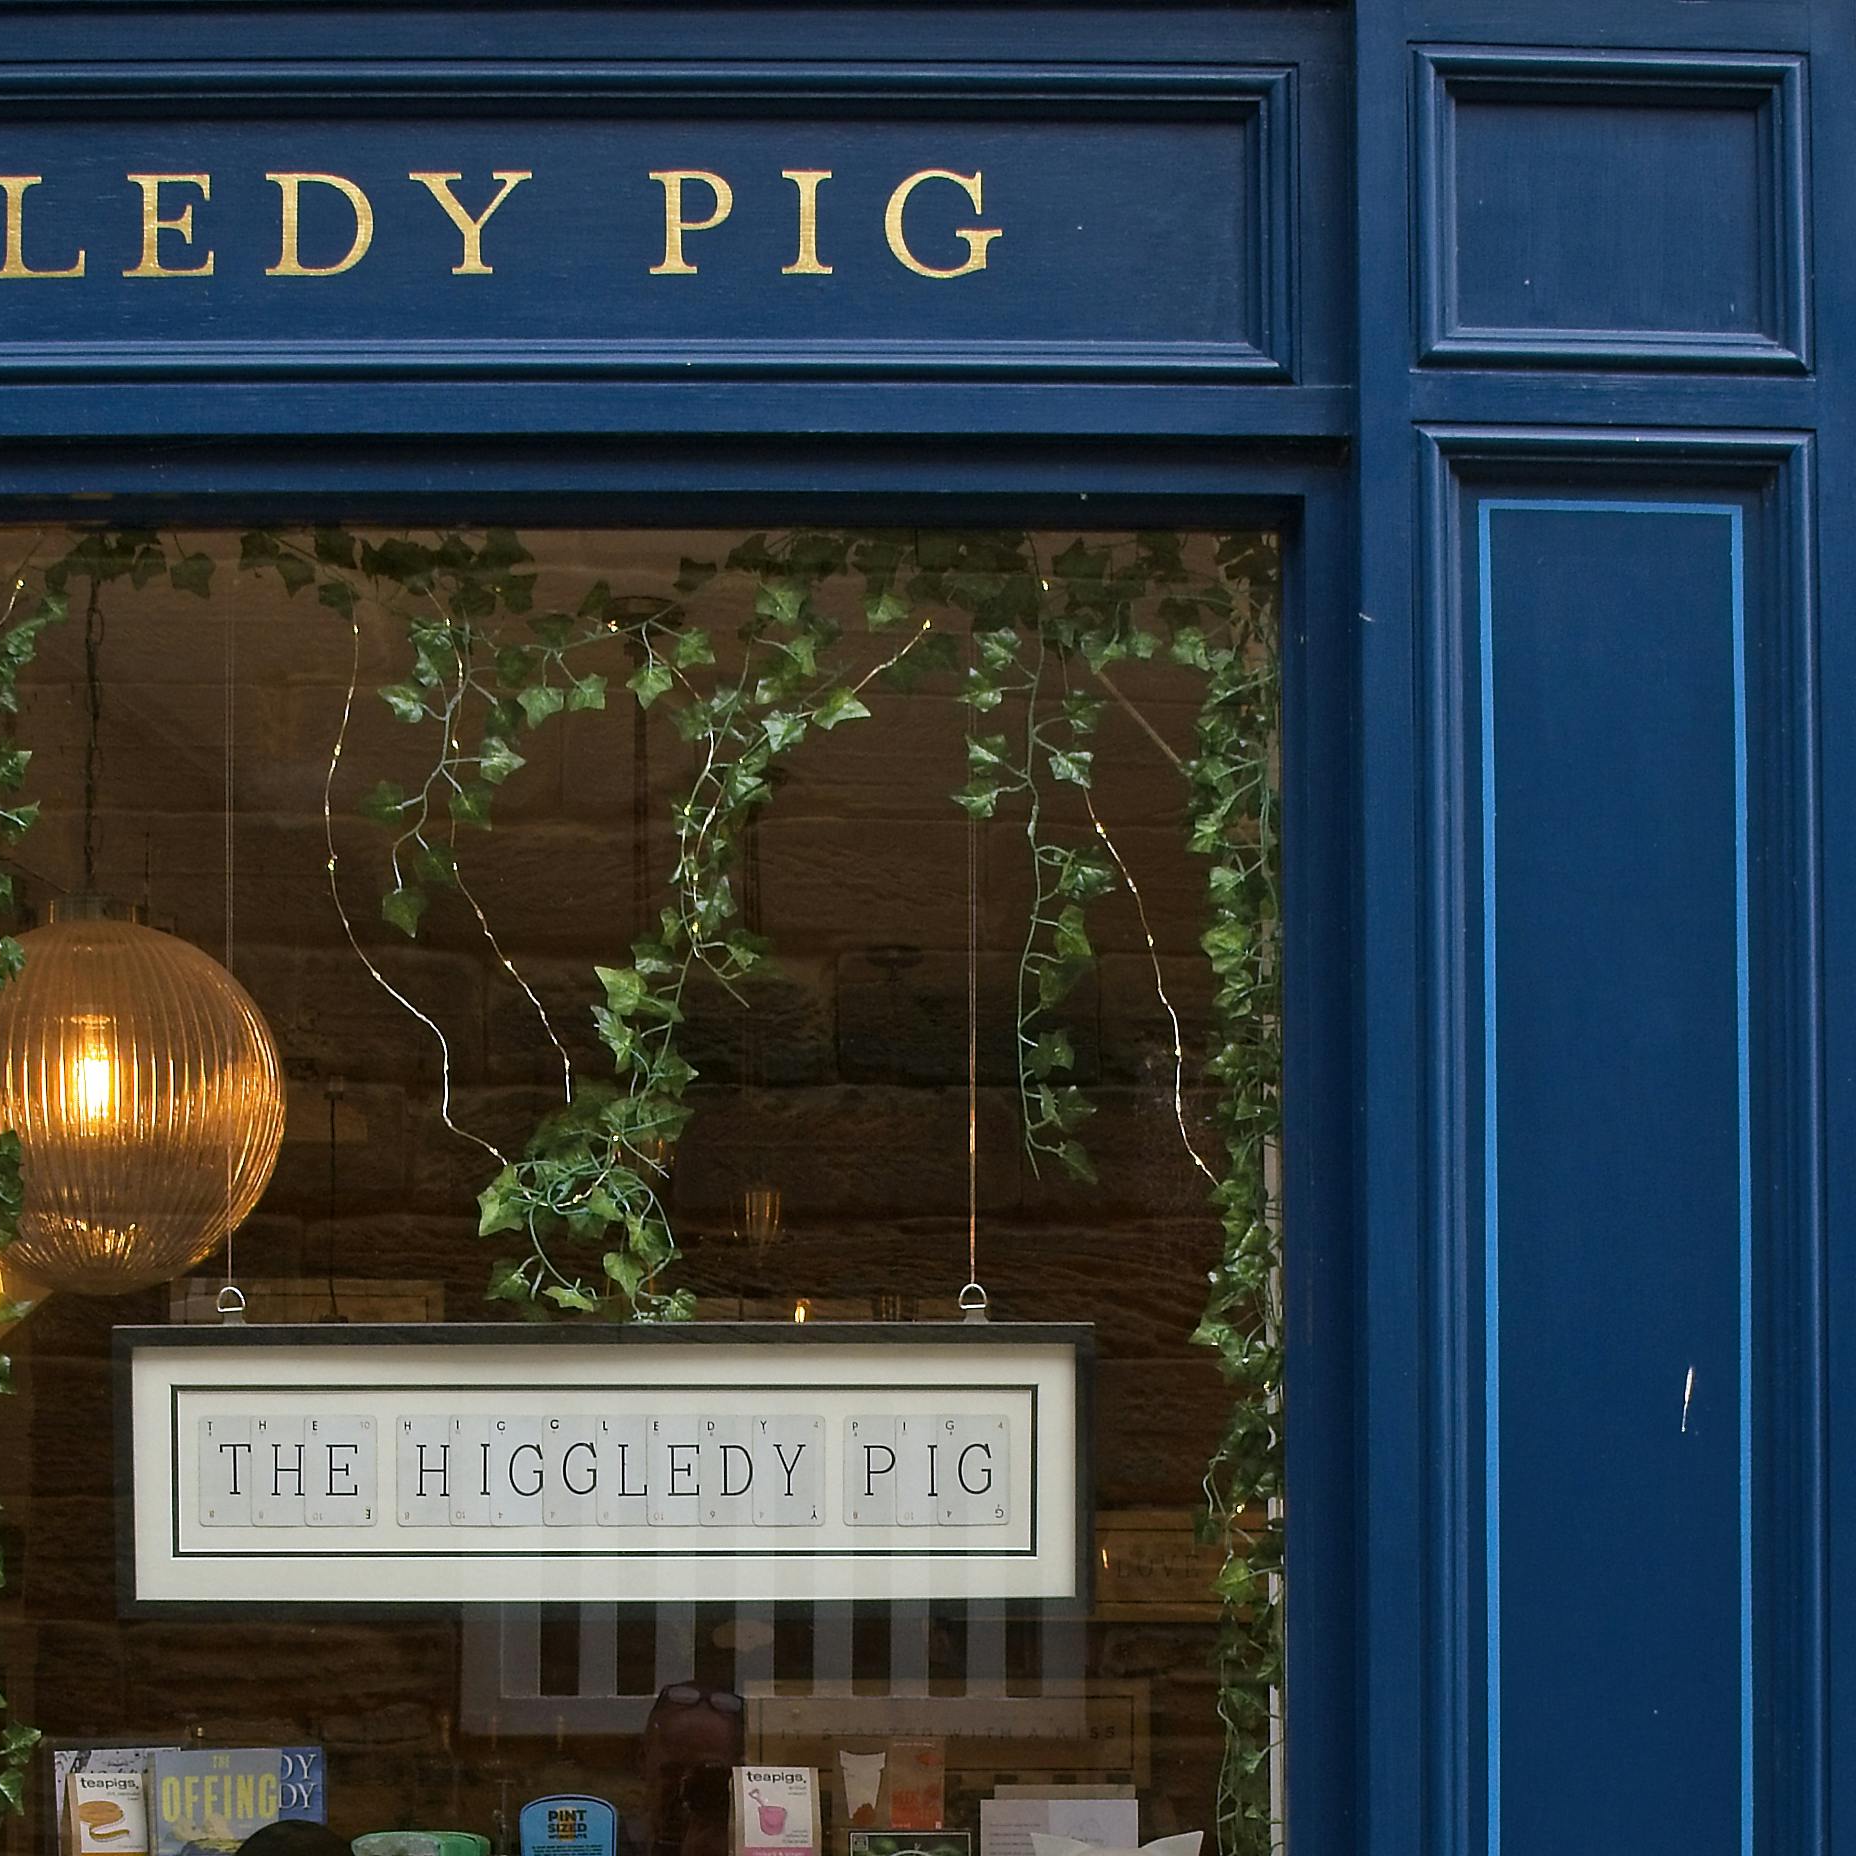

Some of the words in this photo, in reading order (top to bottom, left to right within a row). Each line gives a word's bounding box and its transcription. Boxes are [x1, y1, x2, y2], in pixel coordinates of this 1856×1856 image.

[647, 168, 1004, 281] PIG
[219, 1442, 358, 1497] THE
[415, 1442, 807, 1498] HIGGLEDY
[863, 1442, 993, 1497] PIG
[1117, 1555, 1199, 1578] LOVE
[212, 1755, 230, 1769] THE
[746, 1770, 807, 1785] teapigs.
[161, 1773, 278, 1822] OFFING
[548, 1810, 587, 1822] PINT
[548, 1823, 587, 1833] SIZED
